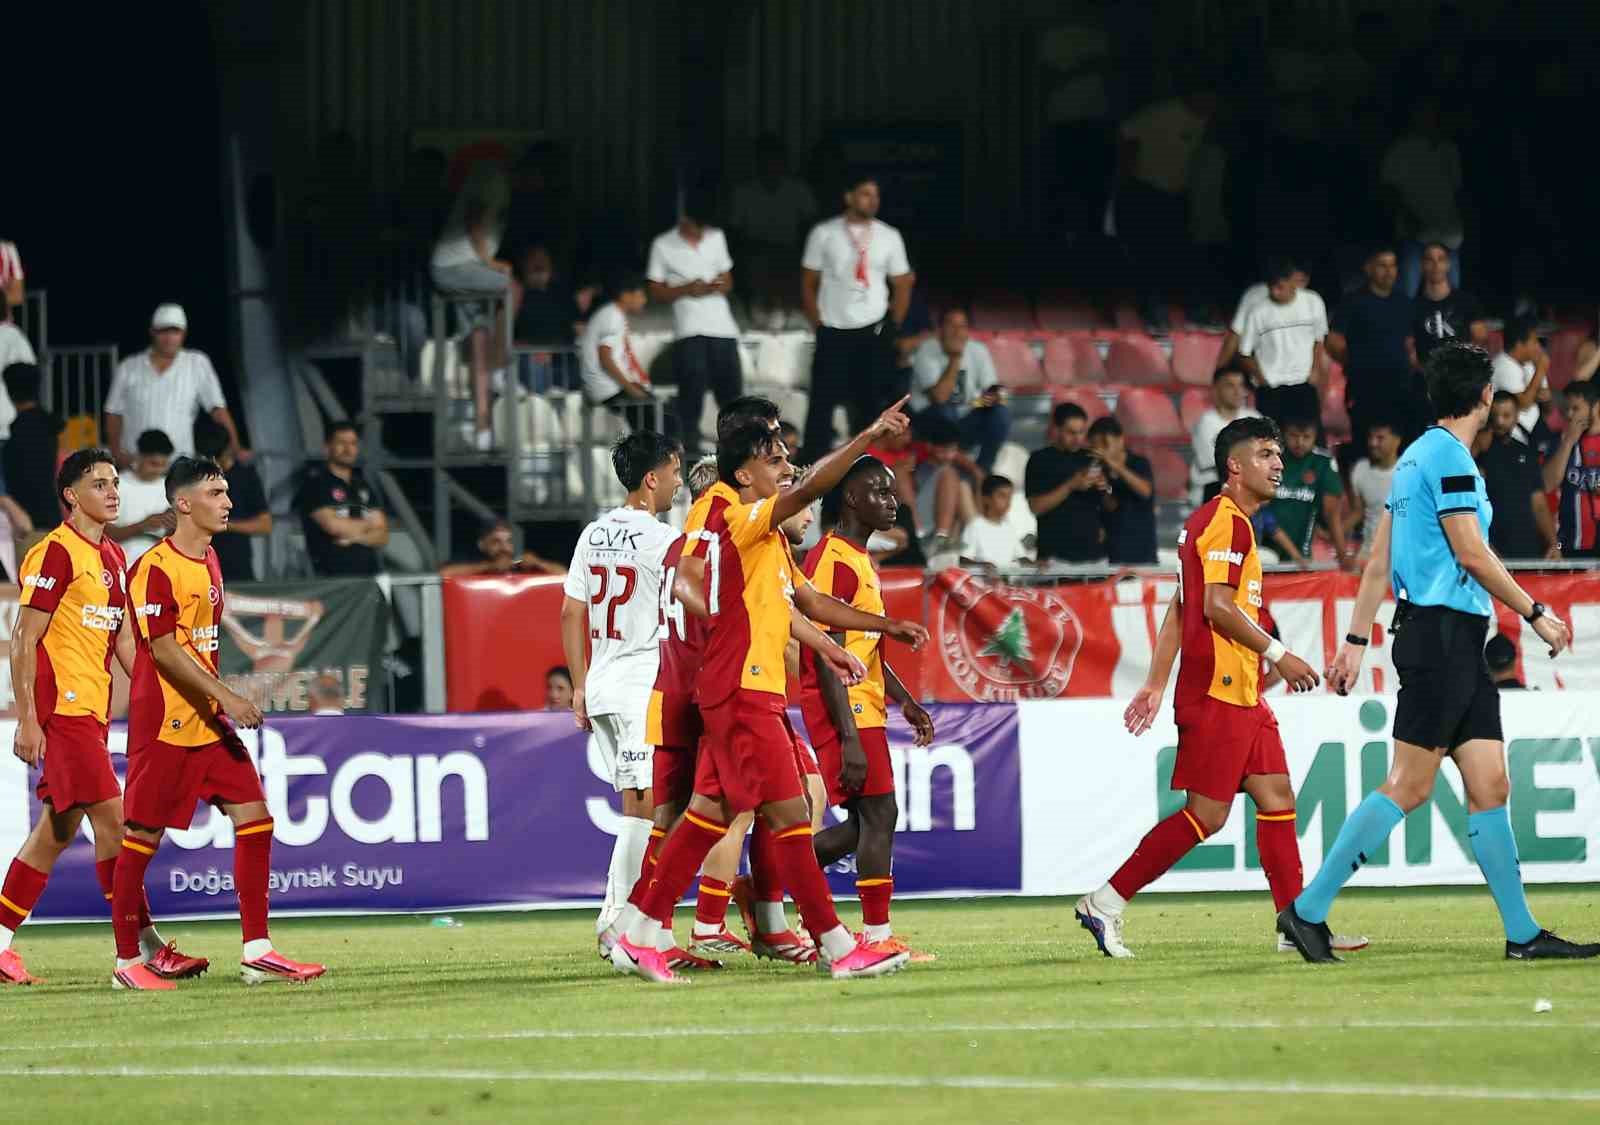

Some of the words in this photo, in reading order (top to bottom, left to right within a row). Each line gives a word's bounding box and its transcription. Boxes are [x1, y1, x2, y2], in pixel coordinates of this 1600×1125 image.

[589, 564, 638, 641] 22
[169, 866, 236, 895] Doğa
[268, 865, 337, 890] aynak
[342, 864, 403, 887] Suyu
